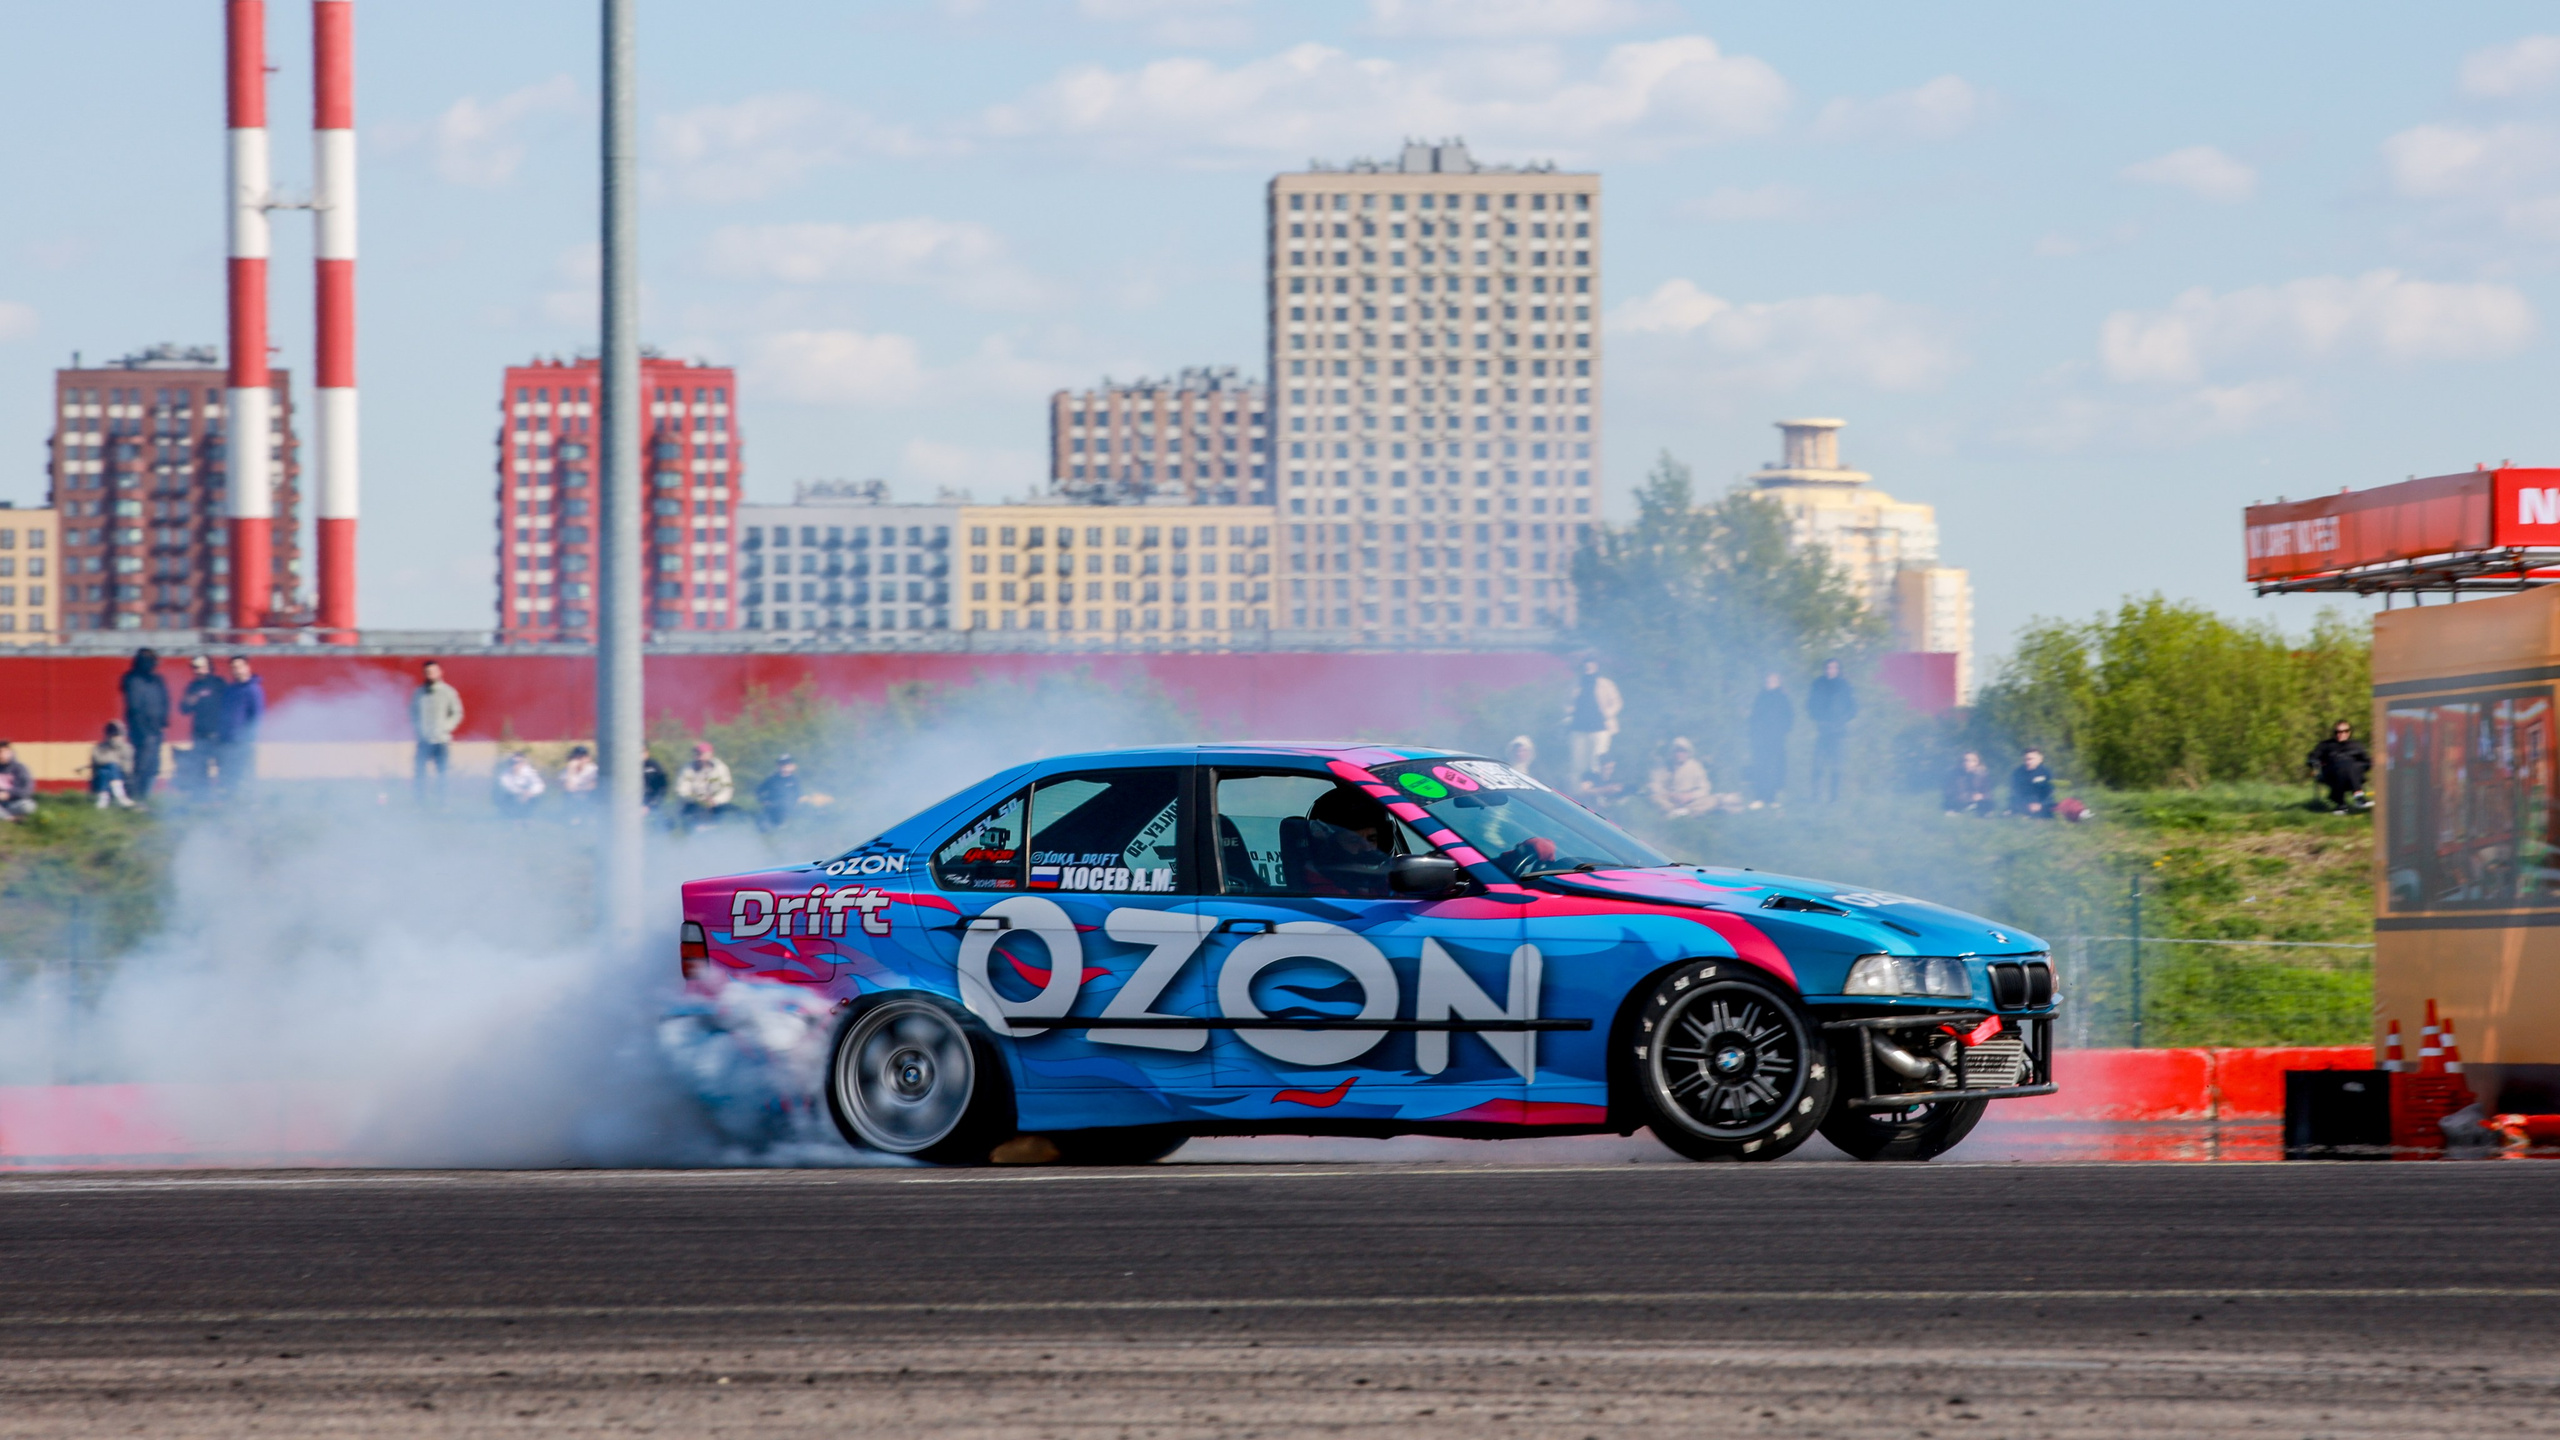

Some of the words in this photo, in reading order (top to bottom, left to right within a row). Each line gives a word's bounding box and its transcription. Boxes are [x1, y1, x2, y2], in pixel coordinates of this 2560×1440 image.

[826, 854, 906, 876] OZON
[731, 884, 892, 939] Drift
[956, 895, 1543, 1085] OZON
